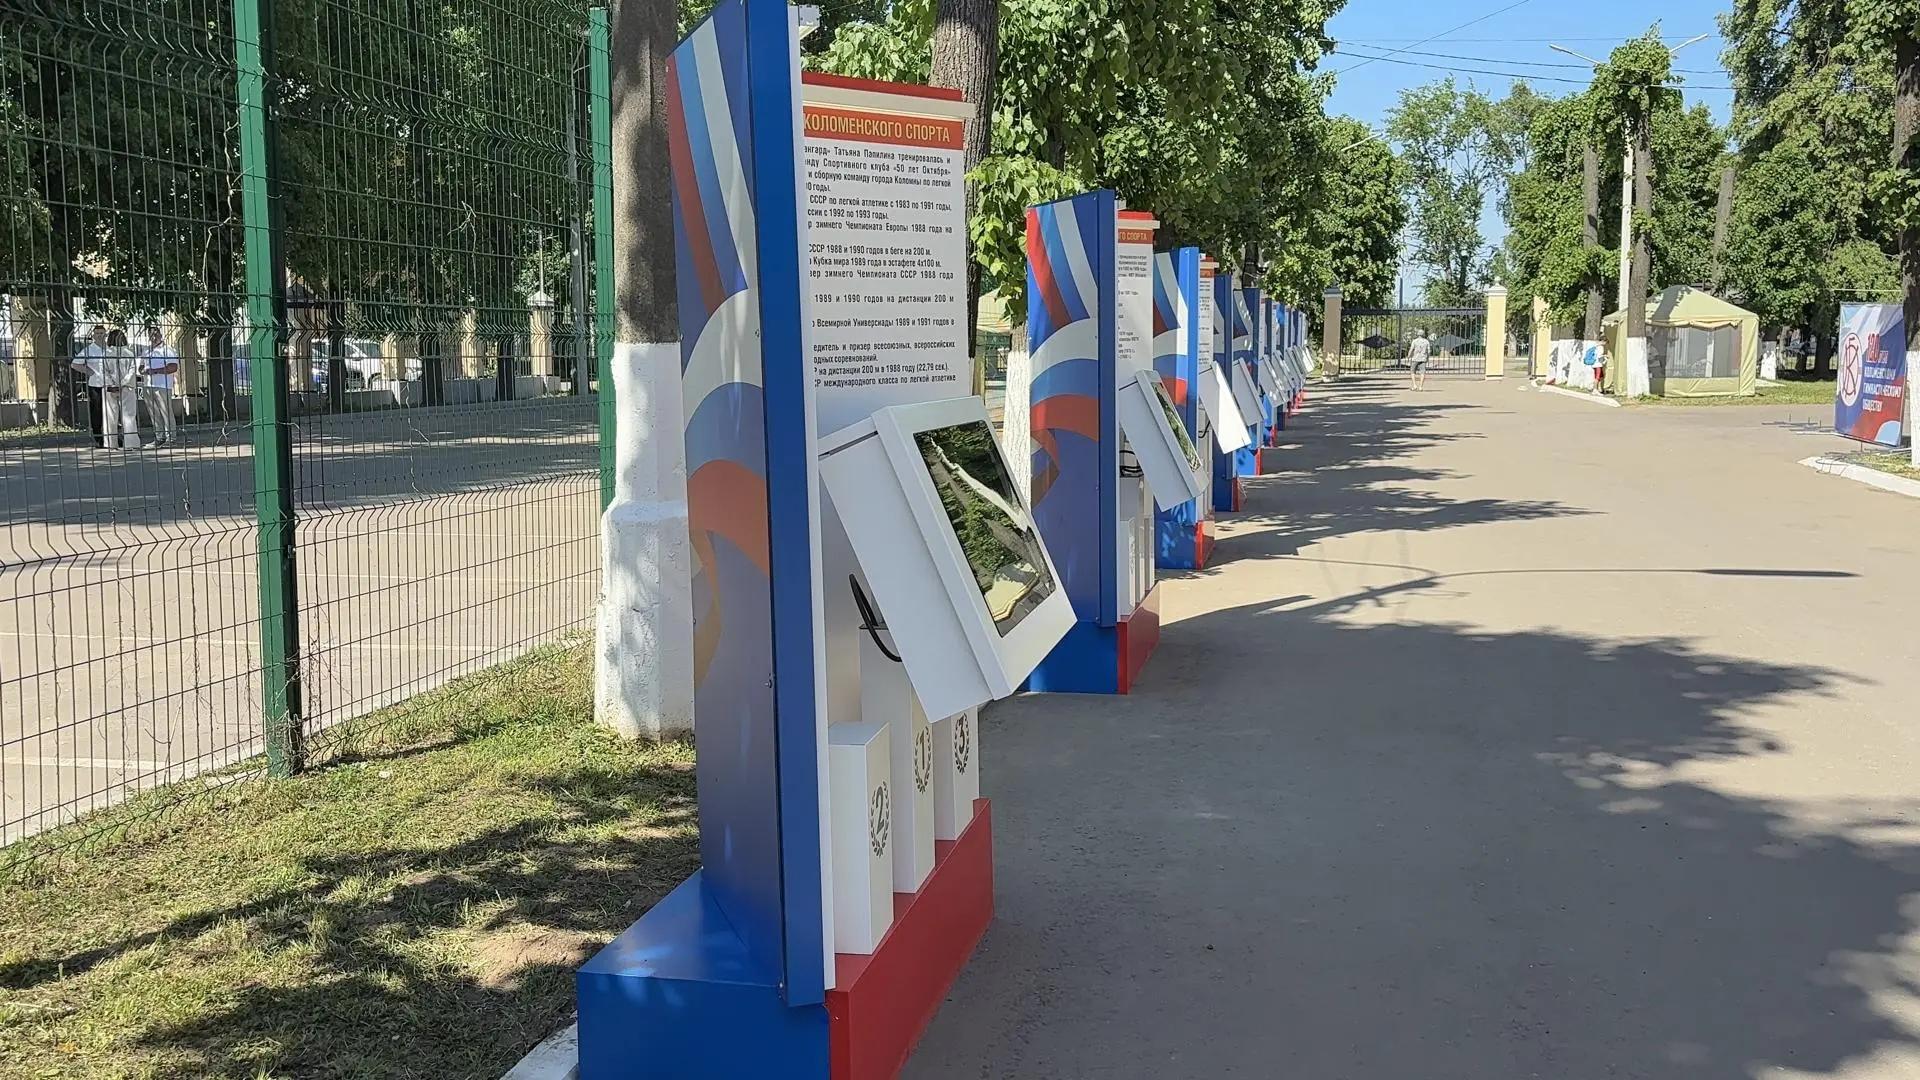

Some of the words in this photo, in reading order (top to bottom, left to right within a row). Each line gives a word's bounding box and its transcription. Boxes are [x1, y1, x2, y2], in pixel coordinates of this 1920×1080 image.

[803, 113, 901, 137] КОЛОМЕНСКОГО
[905, 123, 951, 142] СПОРТА
[834, 146, 861, 158] Татьяна
[864, 149, 895, 160] Папилина
[898, 152, 944, 164] тренировалась
[946, 156, 951, 164] и
[823, 157, 867, 170] Спортивного
[870, 163, 890, 173] клуба
[908, 165, 919, 174] лет
[814, 169, 842, 182] сборную
[843, 174, 870, 184] команду
[871, 176, 893, 185] города
[894, 175, 922, 187] Коломны
[923, 178, 931, 186] по
[932, 177, 951, 188] легкой
[813, 183, 831, 193] годы.
[809, 195, 827, 204] СССР
[828, 197, 837, 205] по
[838, 197, 860, 206] легкой
[861, 200, 889, 208] атлетике
[895, 199, 910, 209] 1983
[911, 202, 919, 210] по
[920, 201, 934, 210] 1991
[935, 203, 952, 211] годы.
[829, 209, 845, 218] 1992
[846, 210, 854, 218] по
[855, 209, 871, 219] 1993
[871, 212, 889, 220] годы.
[816, 221, 843, 230] зимнего
[845, 221, 883, 231] Чемпионата
[885, 223, 909, 233] Европы
[911, 223, 926, 233] 1988
[928, 225, 943, 234] года
[945, 226, 953, 234] на
[826, 244, 843, 254] 1988
[849, 245, 865, 254] 1990
[866, 247, 884, 255] годов
[890, 246, 903, 255] беге
[913, 247, 925, 255] 200
[813, 257, 832, 266] Кубка
[834, 259, 850, 267] мира
[851, 257, 866, 266] 1989
[867, 259, 882, 267] года
[888, 258, 916, 268] эстафете
[824, 270, 854, 278] зимнего
[857, 269, 897, 279] Чемпионата
[900, 270, 917, 279] СССР
[920, 270, 936, 279] 1988
[939, 271, 954, 280] года
[815, 294, 832, 303] 1989
[843, 294, 861, 303] 1990
[864, 295, 884, 303] годов
[898, 295, 932, 304] дистанции
[934, 294, 947, 302] 200
[817, 318, 851, 329] Всемирной
[853, 318, 894, 328] Универсиады
[895, 318, 910, 327] 1989
[917, 318, 931, 326] 1991
[932, 318, 950, 326] годов
[813, 343, 839, 352] едитель
[849, 343, 871, 351] призер
[873, 342, 912, 350] всесоюзных,
[914, 340, 956, 349] всероссийских
[834, 353, 878, 364] соревнований.
[828, 367, 861, 376] дистанции
[861, 365, 873, 374] 200
[886, 364, 901, 373] 1988
[901, 363, 915, 374] году
[823, 377, 876, 389] международного
[878, 376, 899, 384] класса
[900, 376, 908, 384] по
[909, 374, 929, 383] легкой
[931, 374, 956, 382] атлетике
[958, 715, 966, 754] 3
[875, 786, 885, 835] 2
